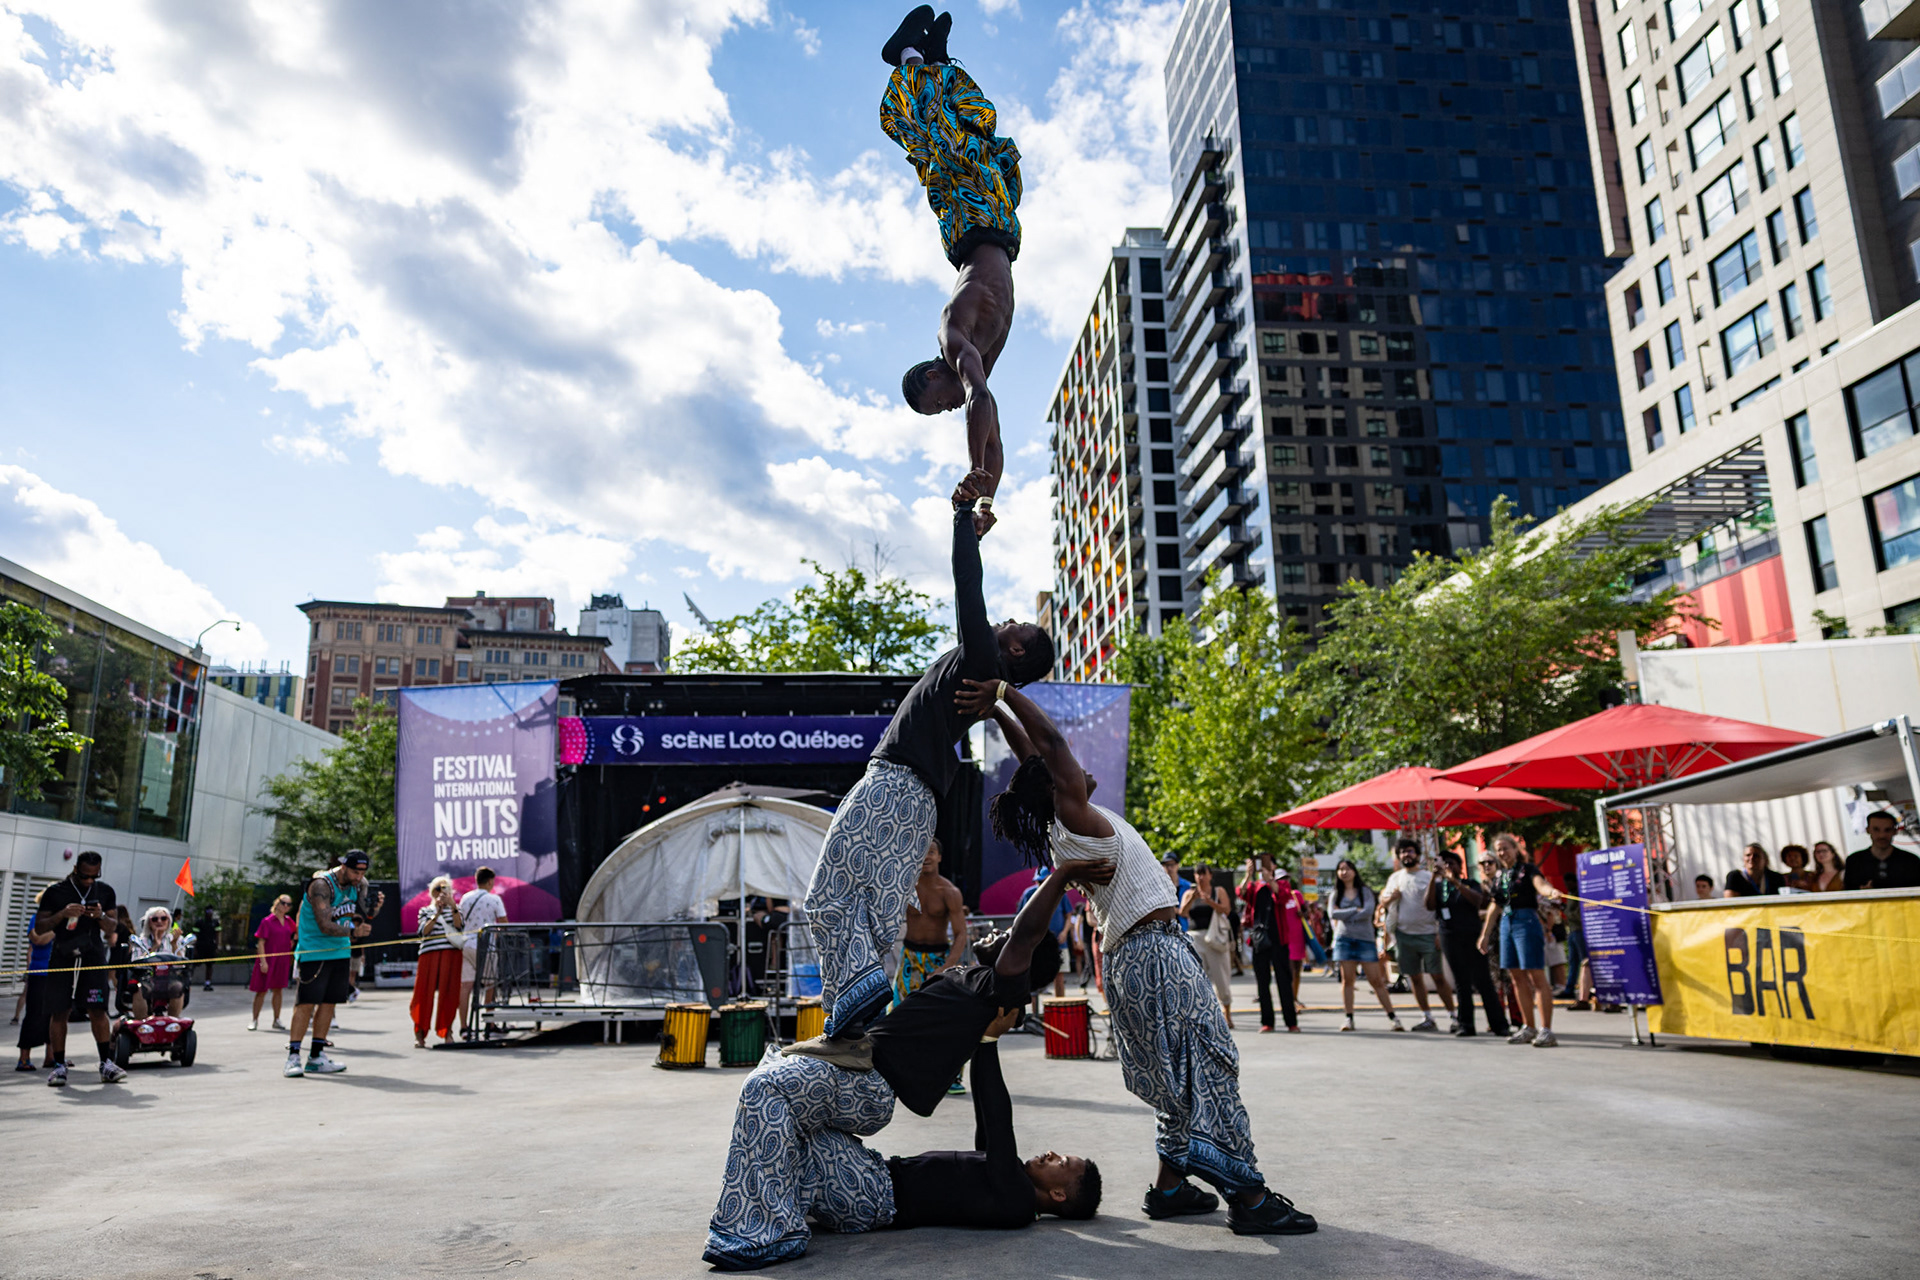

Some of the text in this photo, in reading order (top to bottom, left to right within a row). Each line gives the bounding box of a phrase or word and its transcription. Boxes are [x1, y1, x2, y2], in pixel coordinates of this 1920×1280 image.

[661, 730, 864, 749] SCÈNE Loto Québec
[433, 754, 517, 781] FESTIVAL
[434, 780, 517, 798] INTERNATIONAL
[434, 798, 519, 838] NUITS
[435, 837, 520, 862] D'AFRIQUE
[1724, 926, 1816, 1020] BAR
